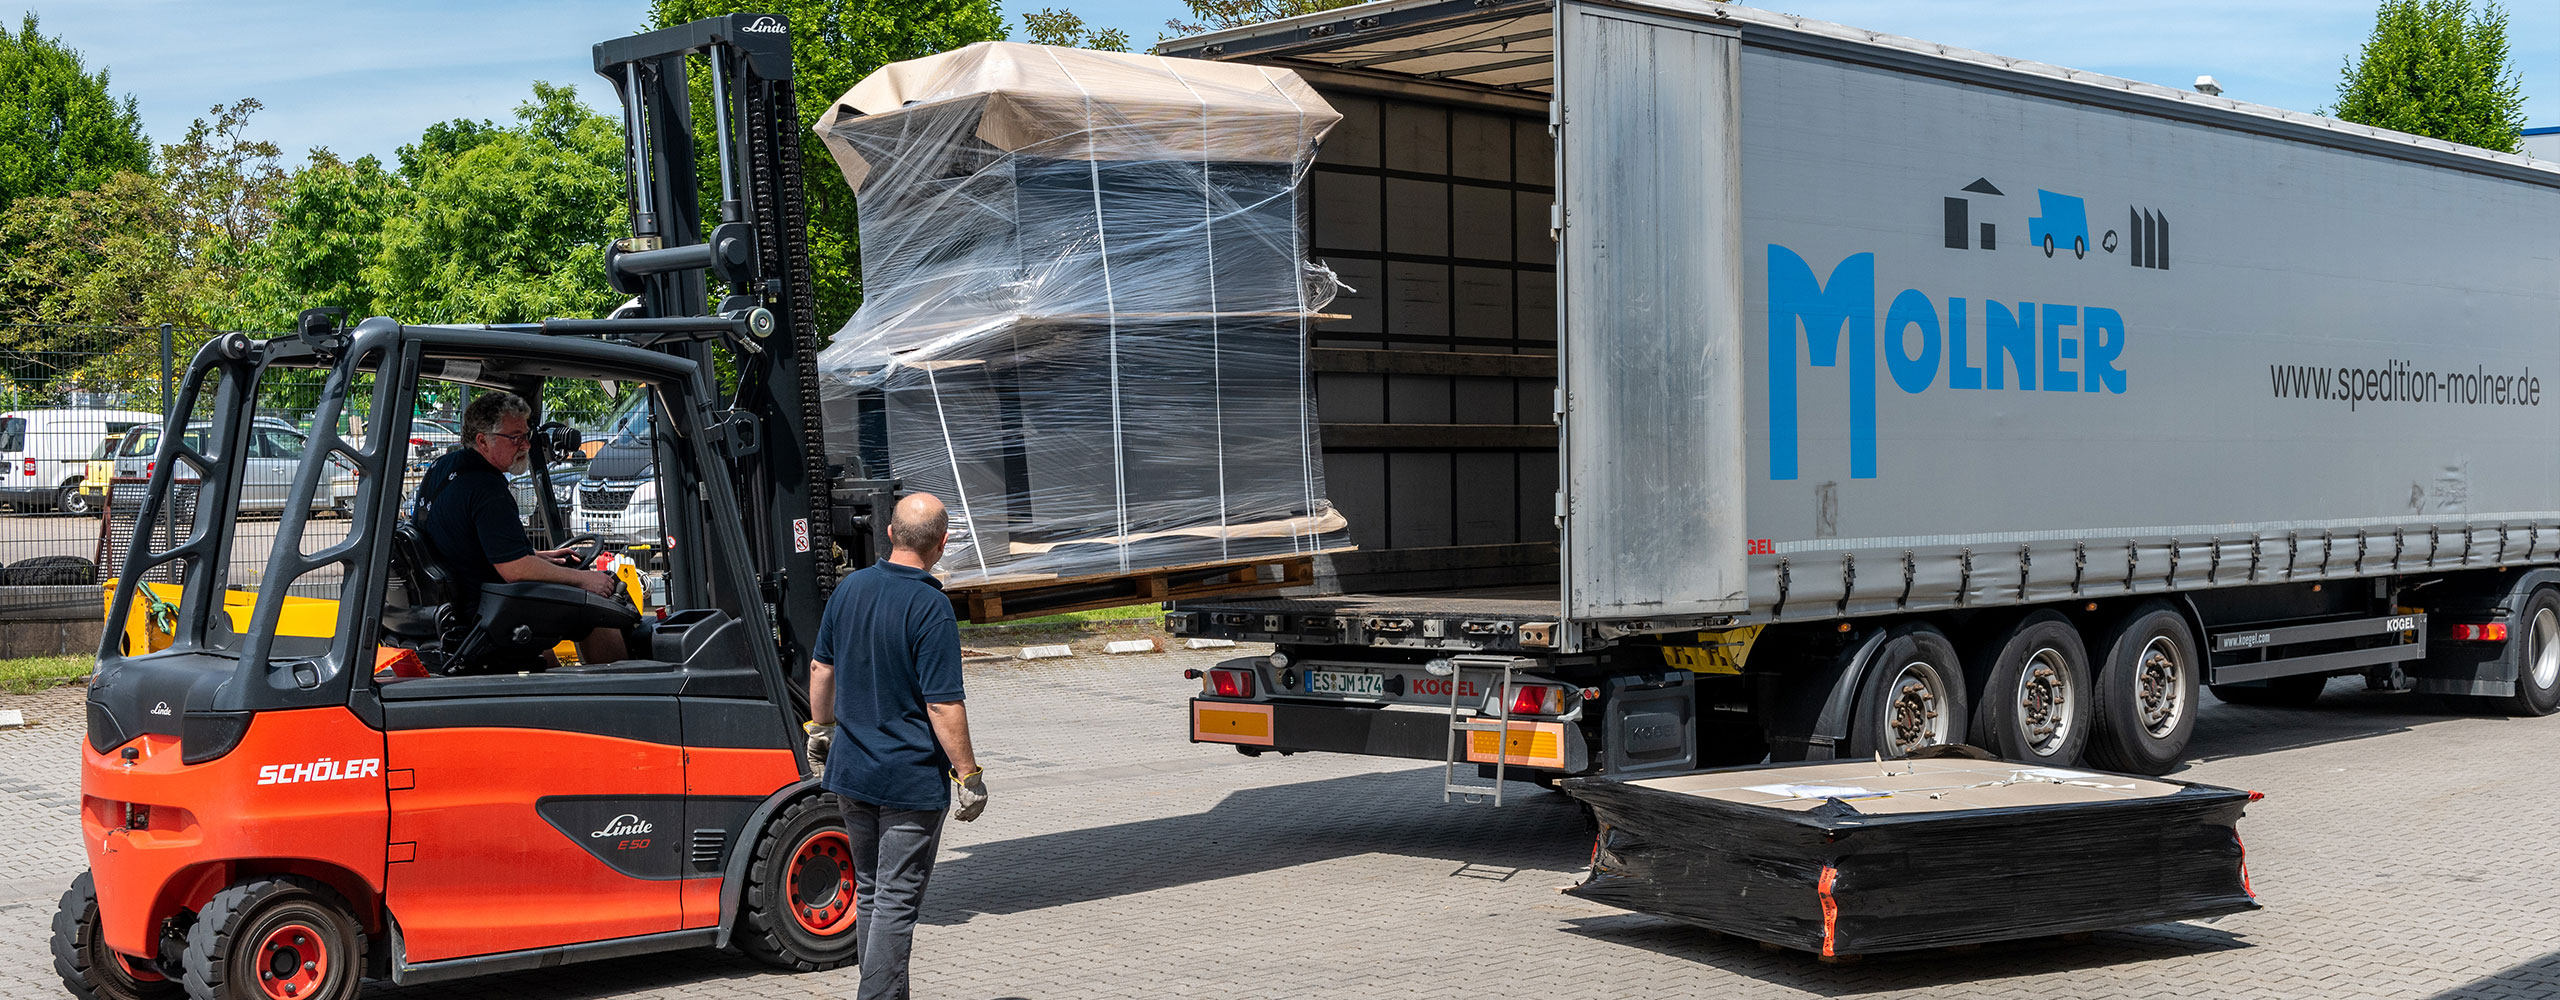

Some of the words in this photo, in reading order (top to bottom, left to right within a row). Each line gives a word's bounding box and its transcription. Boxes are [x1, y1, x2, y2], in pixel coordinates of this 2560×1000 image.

[742, 16, 787, 34] Linde
[1768, 243, 2127, 481] MOLNER
[2270, 359, 2540, 412] www.spedition-molner.de
[2223, 632, 2270, 648] www.koegel.com
[1313, 673, 1330, 691] ES
[1338, 674, 1355, 692] JM
[1358, 676, 1382, 693] 174
[150, 701, 172, 716] Linde
[257, 757, 380, 785] SCHÖLER
[591, 813, 653, 838] Linde
